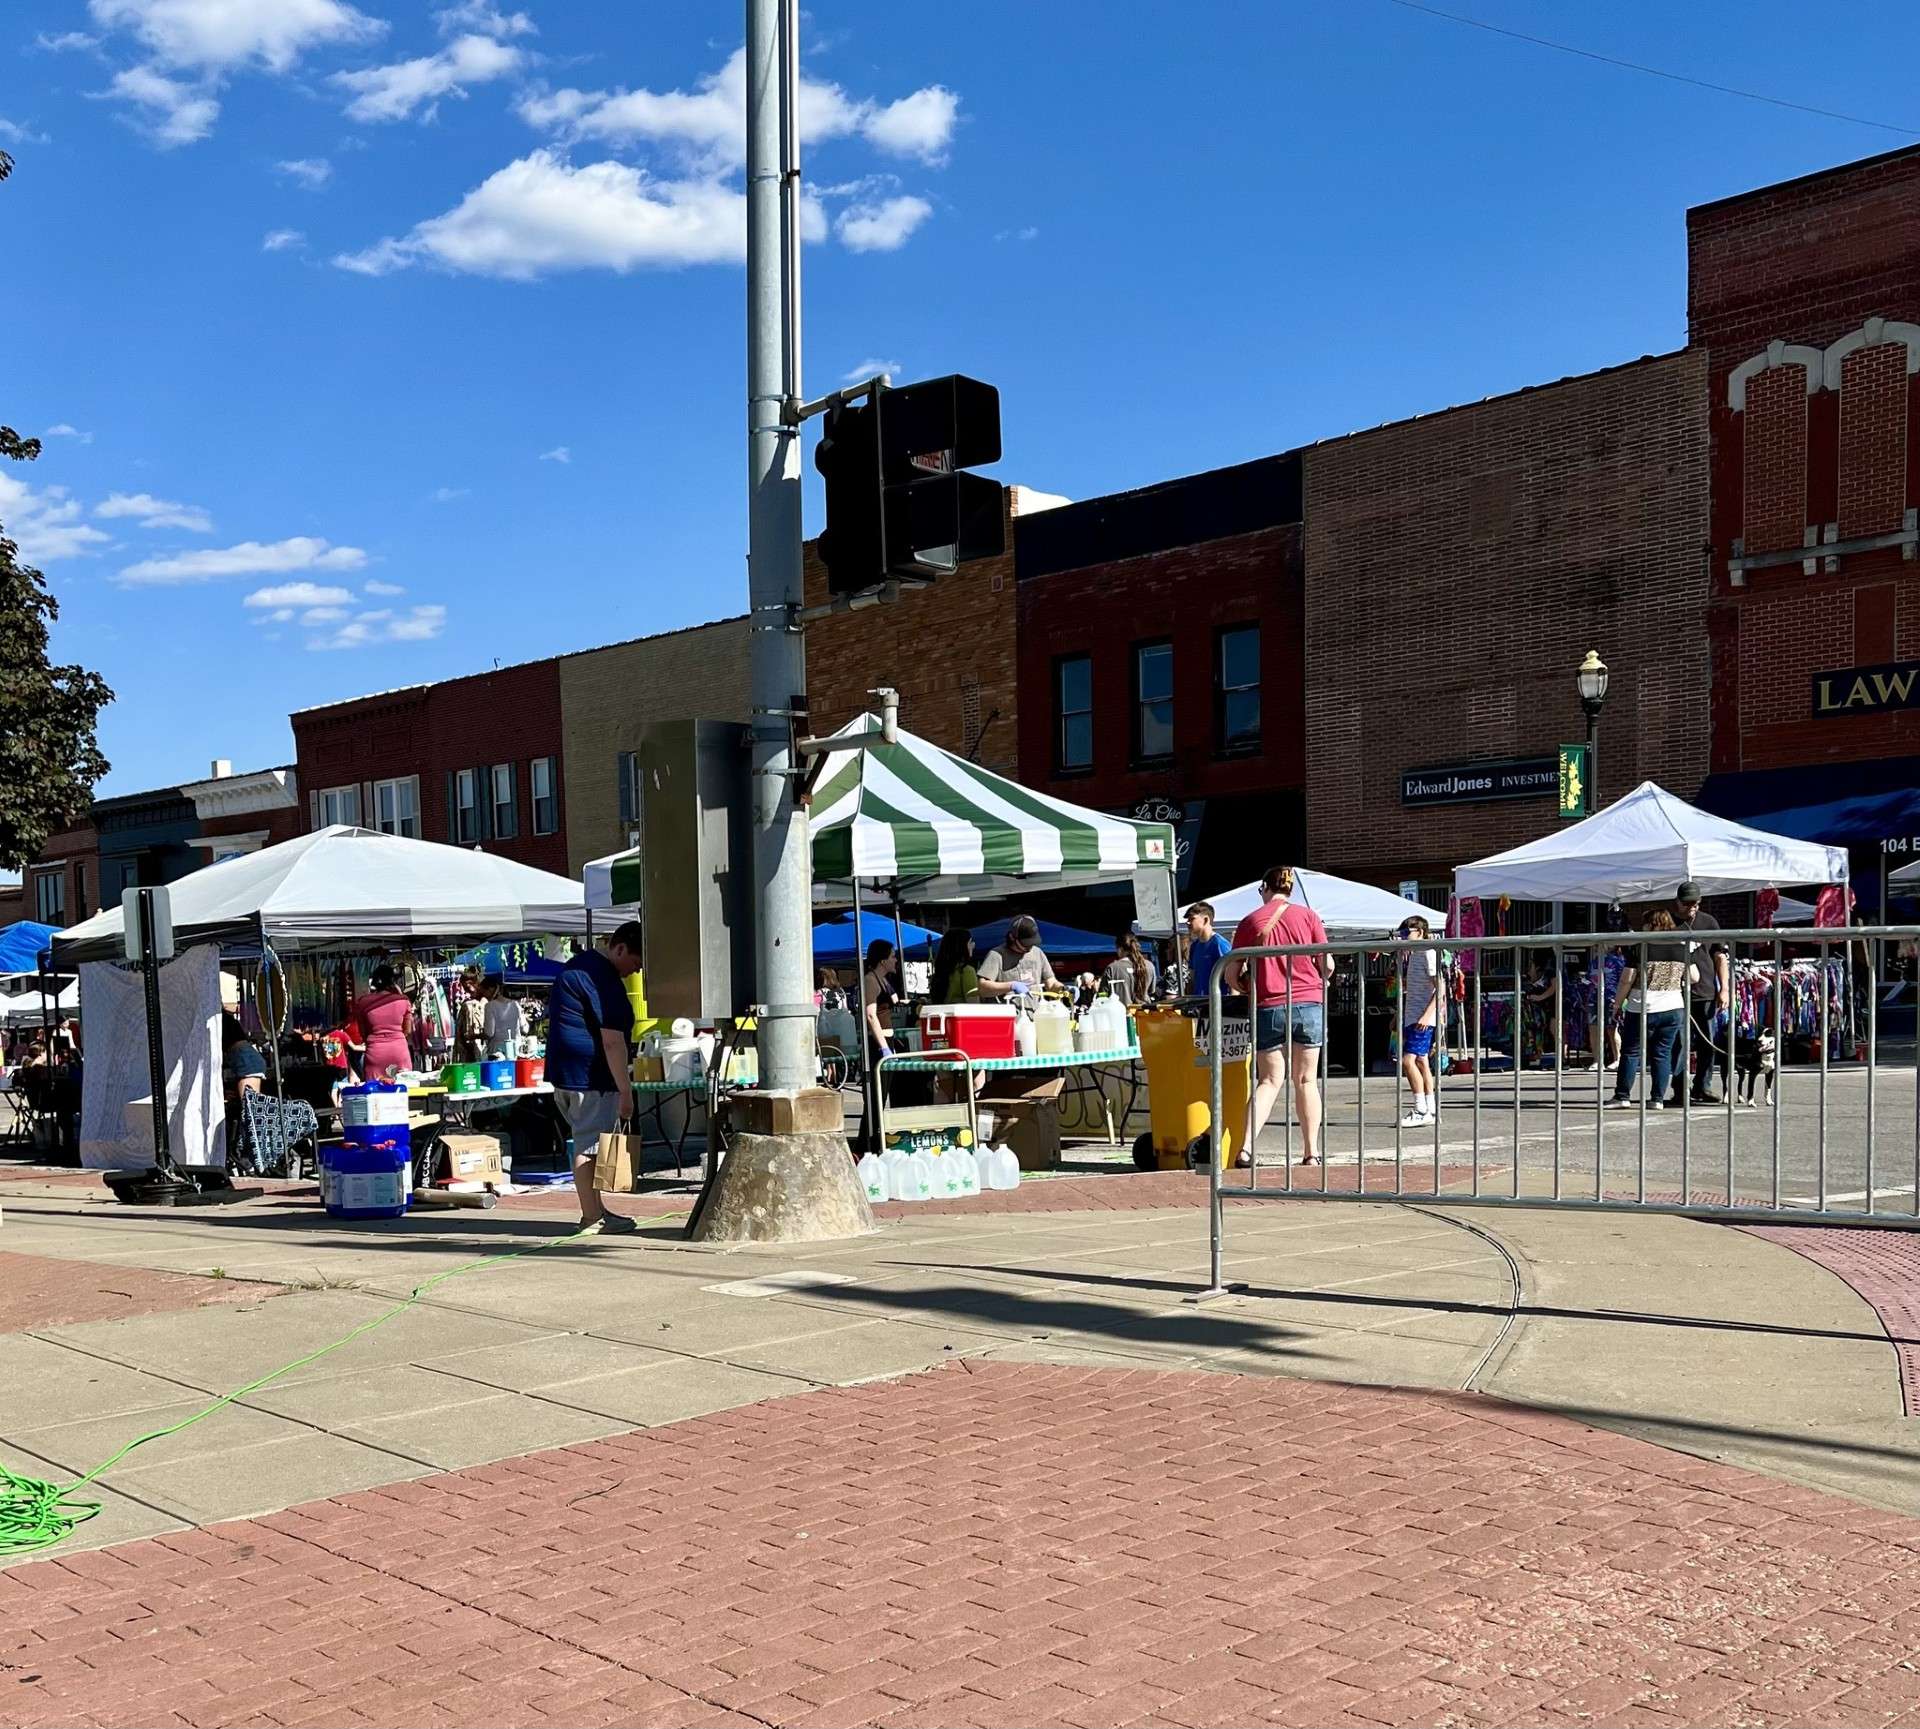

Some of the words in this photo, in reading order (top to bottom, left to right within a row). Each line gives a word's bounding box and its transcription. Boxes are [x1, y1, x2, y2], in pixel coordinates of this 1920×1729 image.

[1817, 669, 1920, 711] LAW
[1559, 752, 1568, 810] WELCOME
[1880, 837, 1908, 853] 104
[1195, 1018, 1251, 1037] MZIN
[910, 1134, 950, 1148] LEMONS
